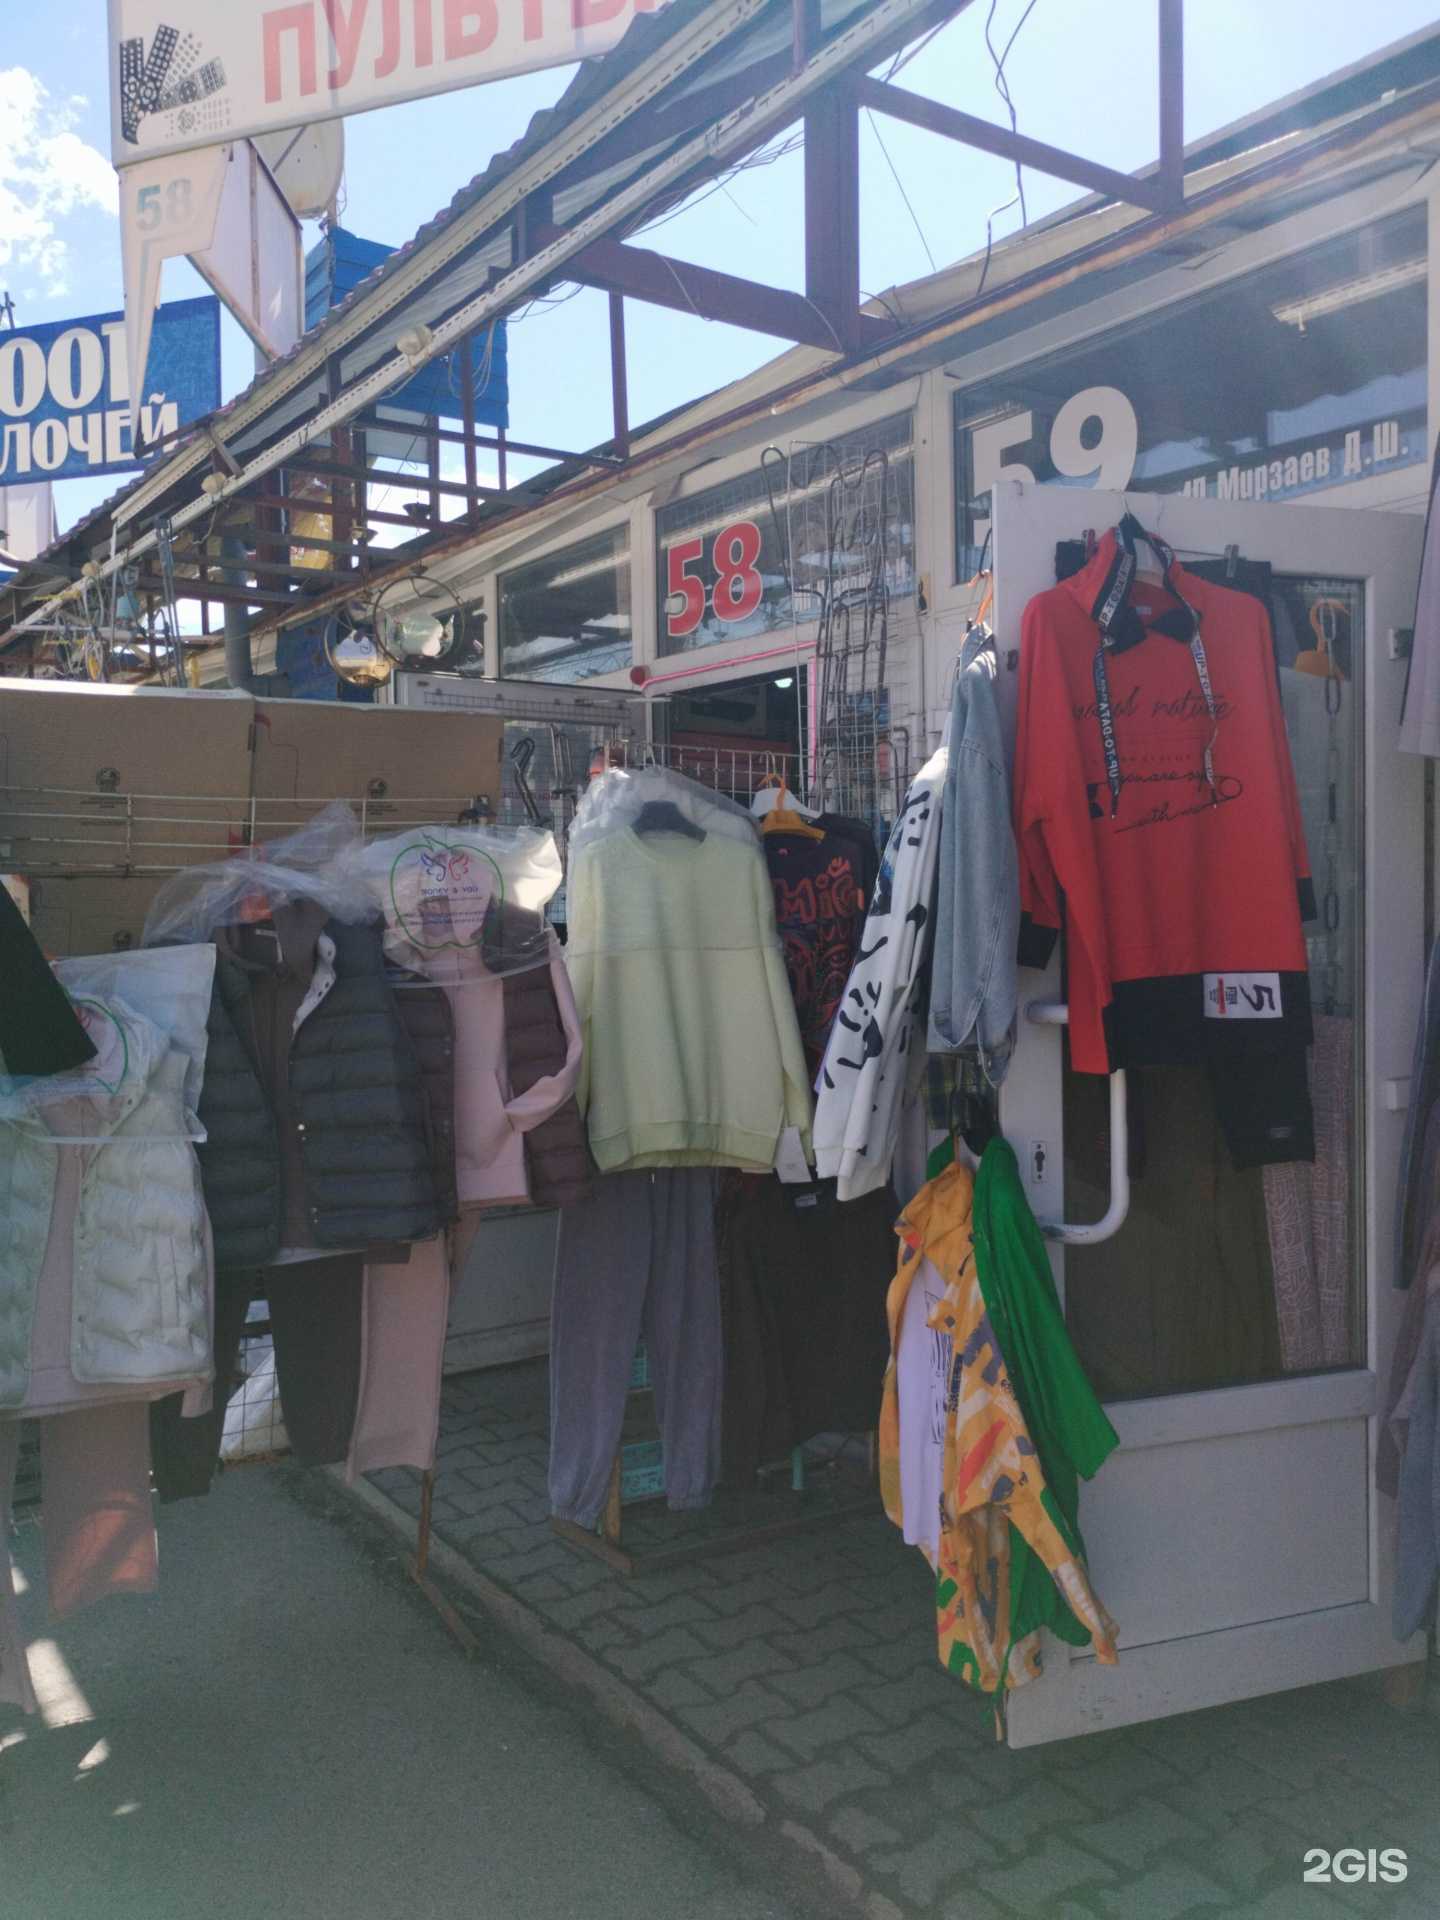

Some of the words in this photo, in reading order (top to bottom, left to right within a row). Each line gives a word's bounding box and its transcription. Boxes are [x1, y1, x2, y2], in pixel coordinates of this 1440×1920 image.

[262, 0, 657, 104] ПУЛЬ
[1217, 447, 1330, 501] Мирзаев
[1343, 421, 1408, 476] Д.Ш.
[667, 520, 763, 637] 58
